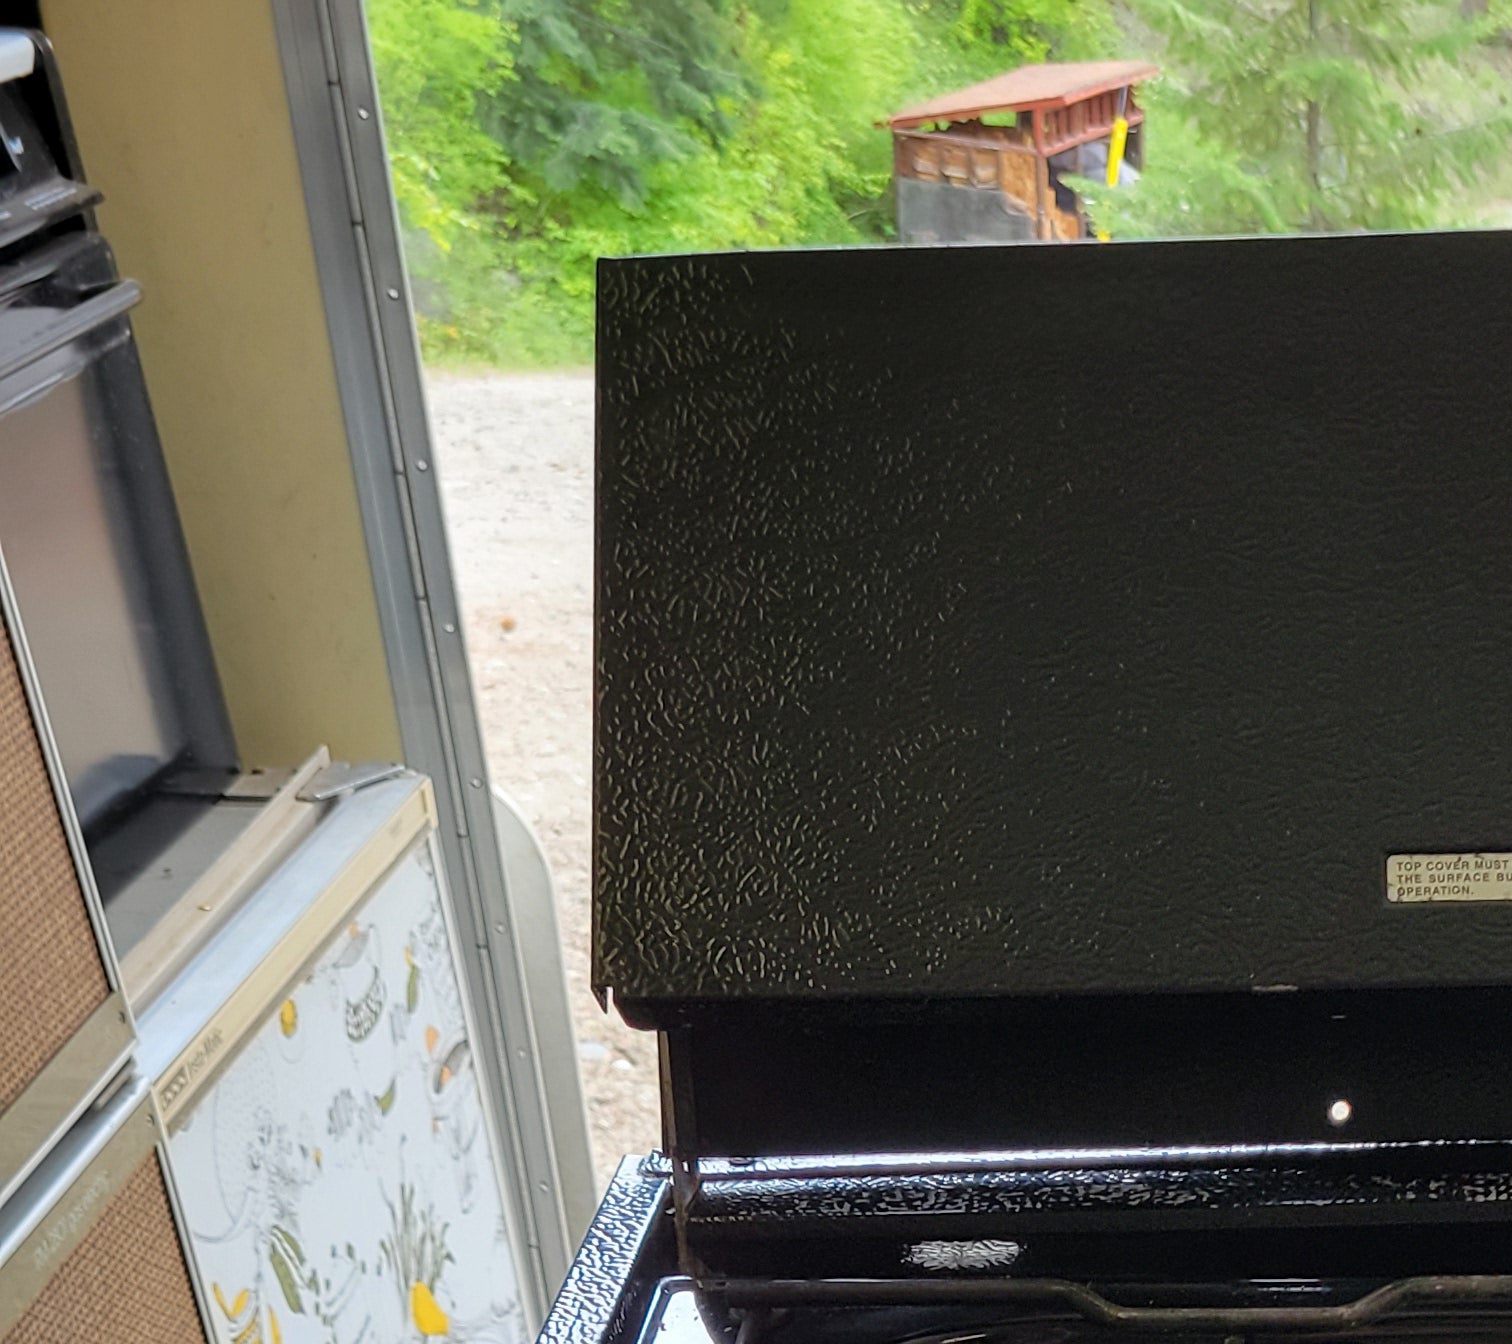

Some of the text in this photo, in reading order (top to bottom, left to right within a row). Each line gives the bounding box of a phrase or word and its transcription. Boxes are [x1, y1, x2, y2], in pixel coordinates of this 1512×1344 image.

[1397, 861, 1422, 872] TOP
[1426, 860, 1469, 871] COVER
[1474, 860, 1508, 870] MUST
[1397, 874, 1422, 884] THE
[1428, 872, 1490, 883] SURFACE
[1397, 885, 1474, 897] OPERATION.
